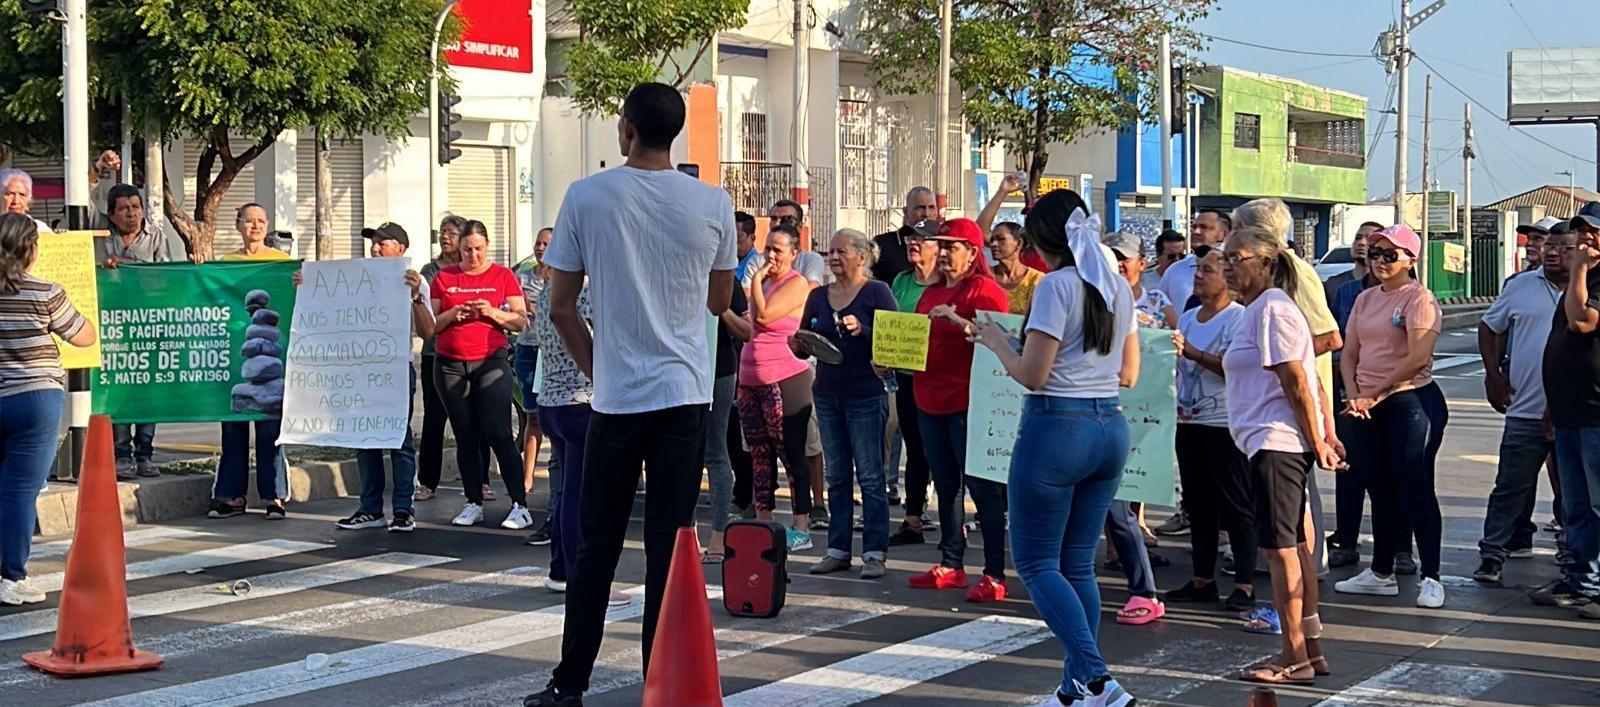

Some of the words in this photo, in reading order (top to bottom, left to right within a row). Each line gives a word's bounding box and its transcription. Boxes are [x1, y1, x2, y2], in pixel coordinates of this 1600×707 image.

[463, 41, 519, 59] SIMPLIFICAR
[100, 306, 231, 325] BIENAVENTURADOS
[300, 310, 328, 328] NOS
[335, 305, 390, 325] TIENES
[100, 326, 124, 340] LOS
[129, 323, 231, 339] PACIFICADORES,
[101, 342, 129, 352] PORQUE
[132, 341, 157, 351] ELLOS
[159, 341, 185, 351] SERAN
[188, 340, 231, 350] LLAMADOS
[297, 338, 391, 363] MAMADOS
[100, 352, 150, 372] HIJOS
[158, 351, 180, 370] DE
[189, 350, 231, 369] DIOS
[100, 373, 110, 385] S.
[115, 372, 151, 384] MATEO
[155, 372, 175, 383] 5:9
[179, 370, 231, 383] RVR1960
[289, 371, 354, 390] PAGAMOS
[367, 372, 394, 389] POR
[319, 393, 364, 409] AGUA
[287, 417, 297, 433] Y
[303, 417, 323, 433] NO
[329, 417, 345, 432] LA
[352, 416, 408, 433] TENEMOS
